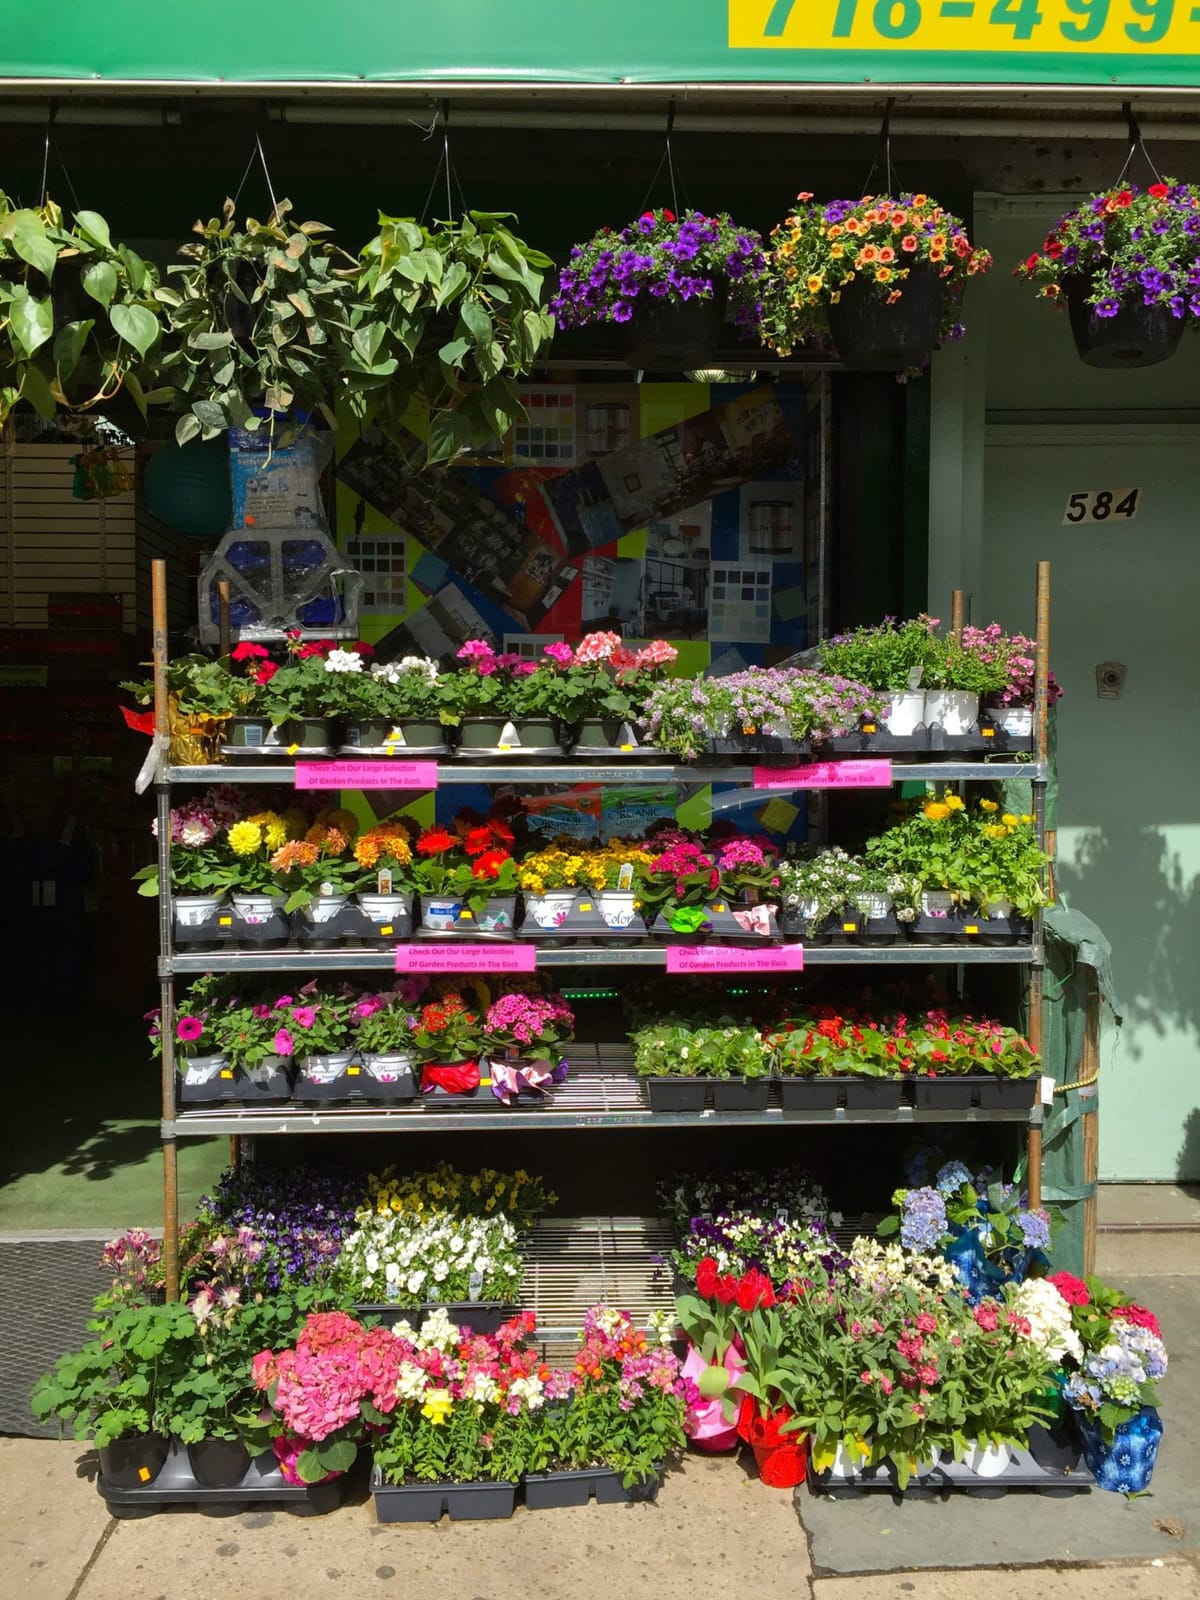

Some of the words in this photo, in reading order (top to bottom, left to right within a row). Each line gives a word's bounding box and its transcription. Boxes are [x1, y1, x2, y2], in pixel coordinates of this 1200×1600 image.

[763, 0, 1200, 43] 718-499
[1066, 488, 1139, 522] 584
[309, 764, 330, 772] Check
[332, 764, 346, 772] Out
[348, 764, 361, 772] Our
[362, 764, 382, 773] Large
[383, 764, 416, 772] Selection
[309, 777, 318, 785] Of
[319, 777, 346, 785] Garden
[347, 777, 379, 785] Products
[380, 777, 388, 785] In
[389, 777, 402, 785] The
[404, 777, 421, 785] Back
[461, 948, 480, 956] Large
[689, 961, 715, 969] Garden
